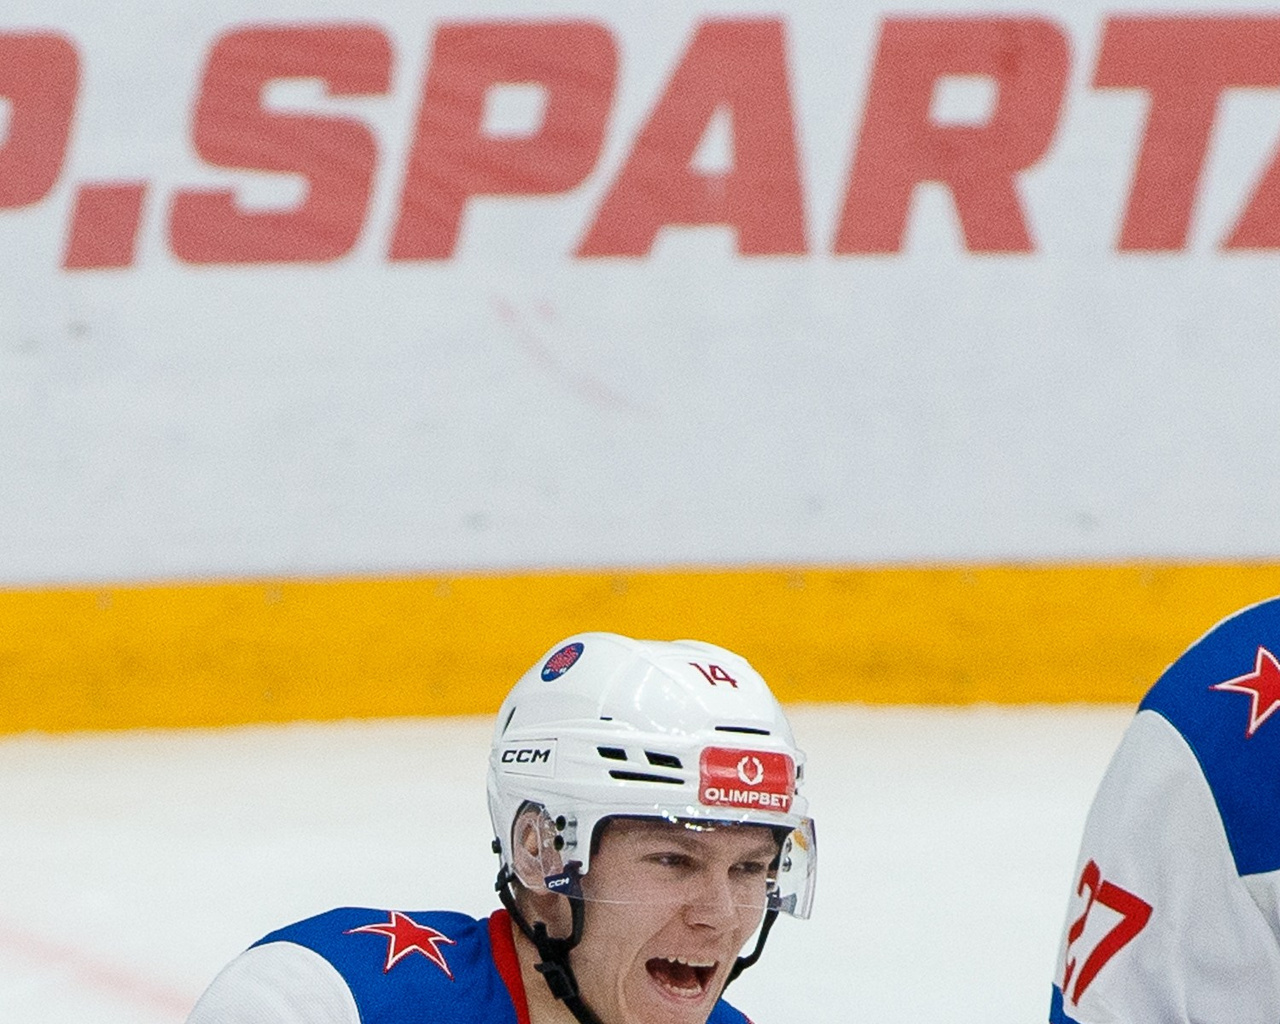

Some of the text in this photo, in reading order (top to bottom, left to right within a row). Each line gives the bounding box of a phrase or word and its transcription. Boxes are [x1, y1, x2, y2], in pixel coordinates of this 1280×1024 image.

[688, 662, 739, 688] 14
[501, 749, 550, 763] CCM
[704, 787, 789, 807] OLIMPBET
[548, 877, 570, 889] CCM
[1063, 859, 1153, 1007] 27
